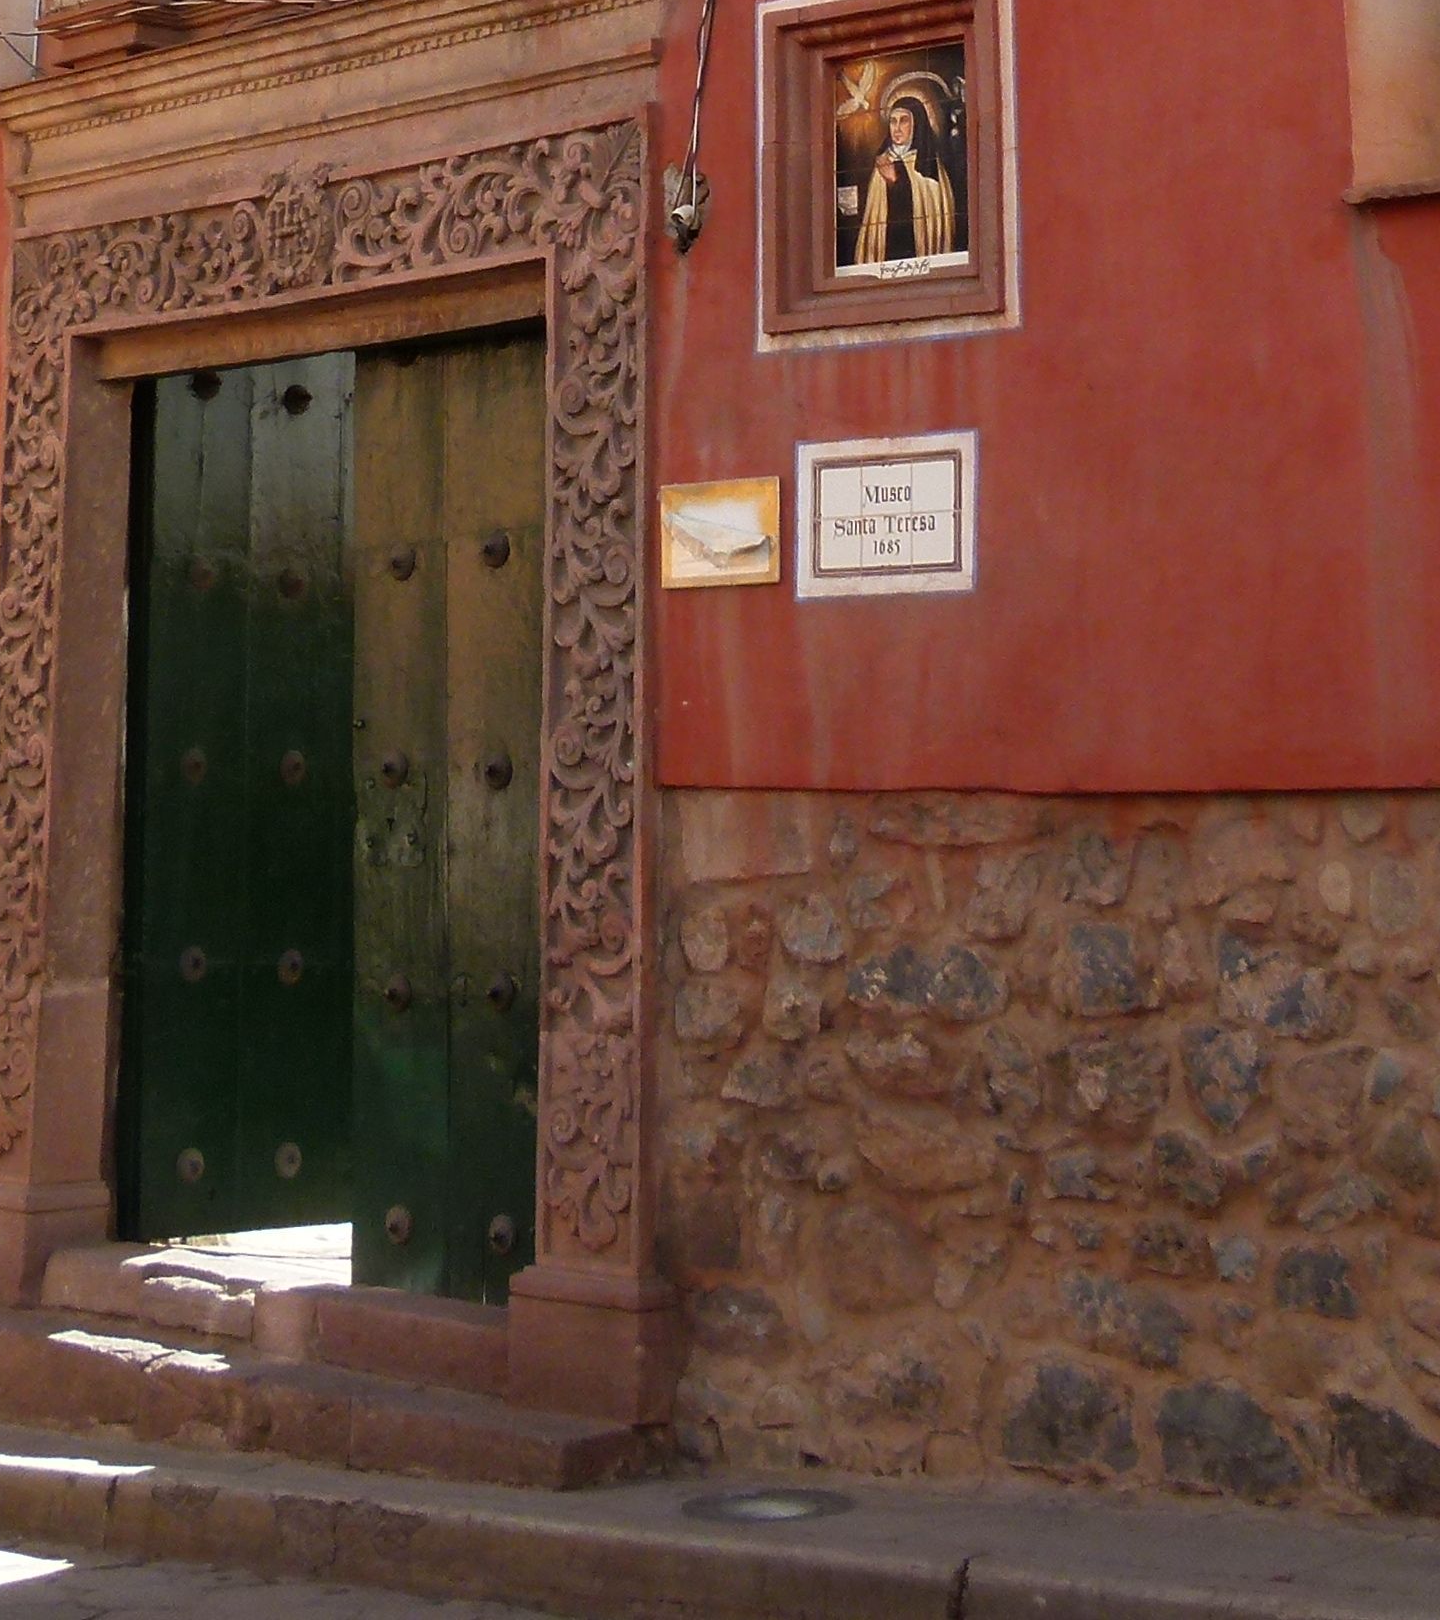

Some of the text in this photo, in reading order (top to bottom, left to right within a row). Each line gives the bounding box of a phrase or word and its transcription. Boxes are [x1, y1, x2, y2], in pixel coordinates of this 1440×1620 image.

[863, 485, 911, 507] Museo
[834, 515, 936, 538] Santa Teresa
[873, 539, 900, 555] 1685
